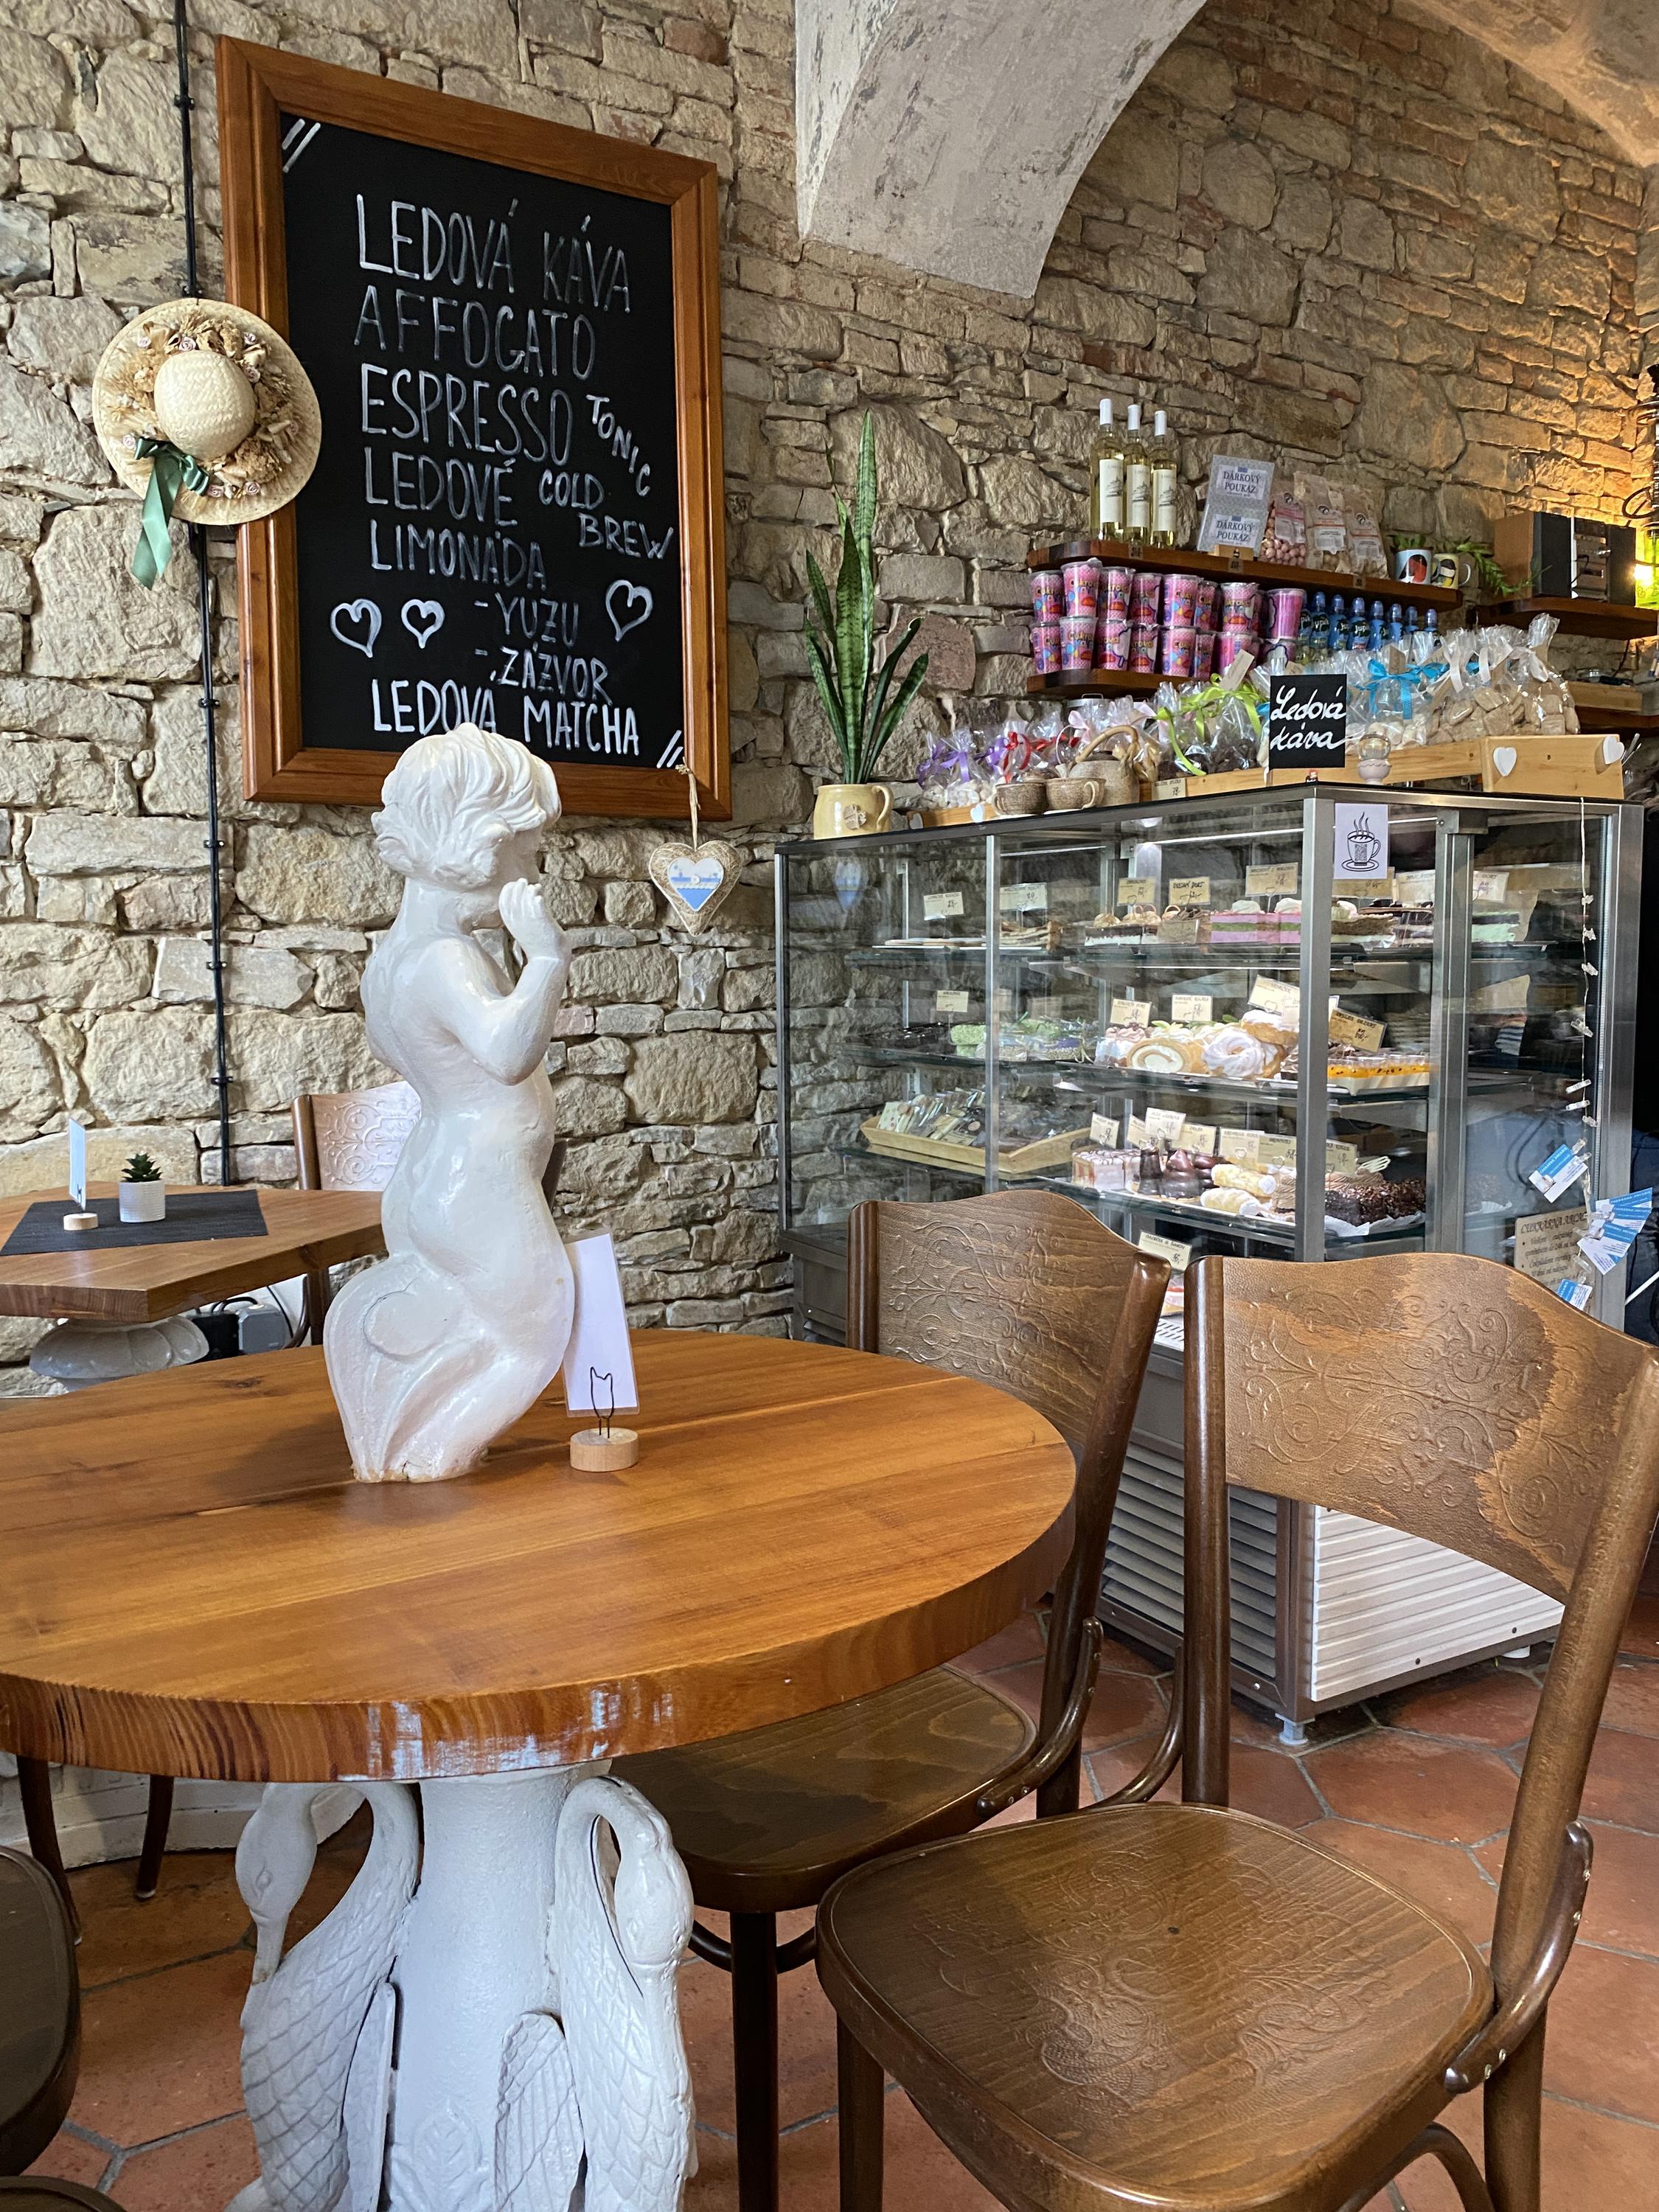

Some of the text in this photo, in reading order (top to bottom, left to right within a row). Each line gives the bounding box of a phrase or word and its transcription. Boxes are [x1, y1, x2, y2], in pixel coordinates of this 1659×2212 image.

[356, 195, 630, 313] LEDOVÁ KÁVA
[354, 285, 596, 380] AFFOGATO
[361, 363, 651, 497] ESPRESSO TONIC
[364, 445, 518, 526] LEDOVÉ
[538, 468, 605, 510] COLD
[370, 519, 547, 591] LIMONÁDA
[578, 512, 674, 560] BREW
[524, 695, 640, 757] MATCHA
[1270, 685, 1347, 721] Ledová
[1270, 722, 1346, 751] káva
